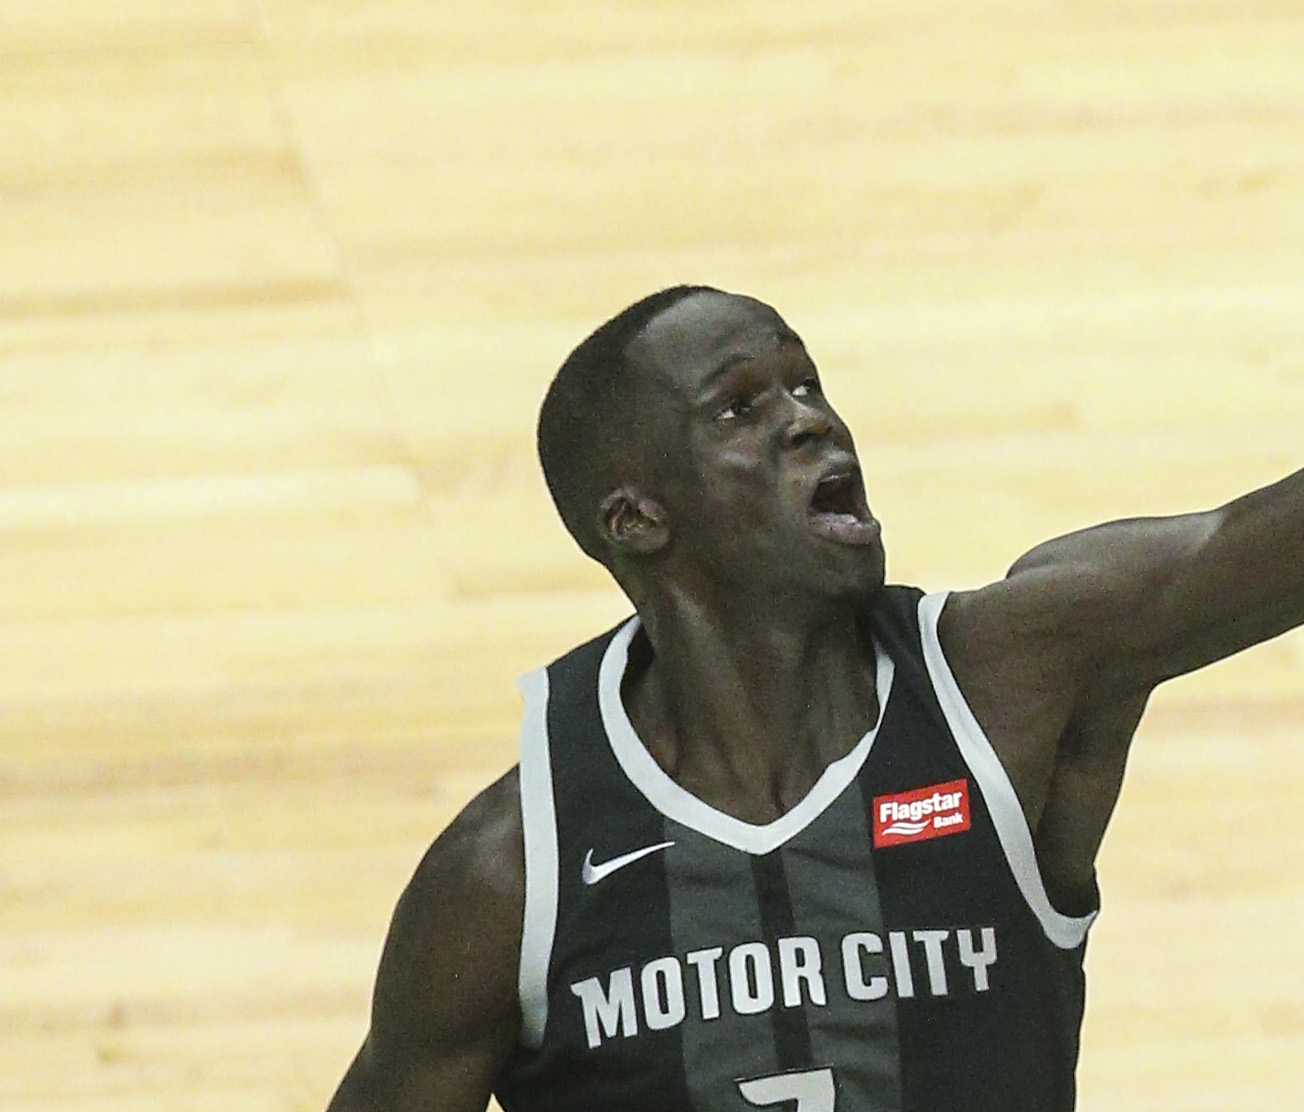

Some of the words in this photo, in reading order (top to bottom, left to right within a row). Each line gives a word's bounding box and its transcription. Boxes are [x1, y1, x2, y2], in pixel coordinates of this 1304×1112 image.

[880, 792, 963, 823] Flagstar
[933, 812, 964, 829] Bank
[570, 936, 827, 1049] MOTOR
[841, 927, 998, 1001] CITY
